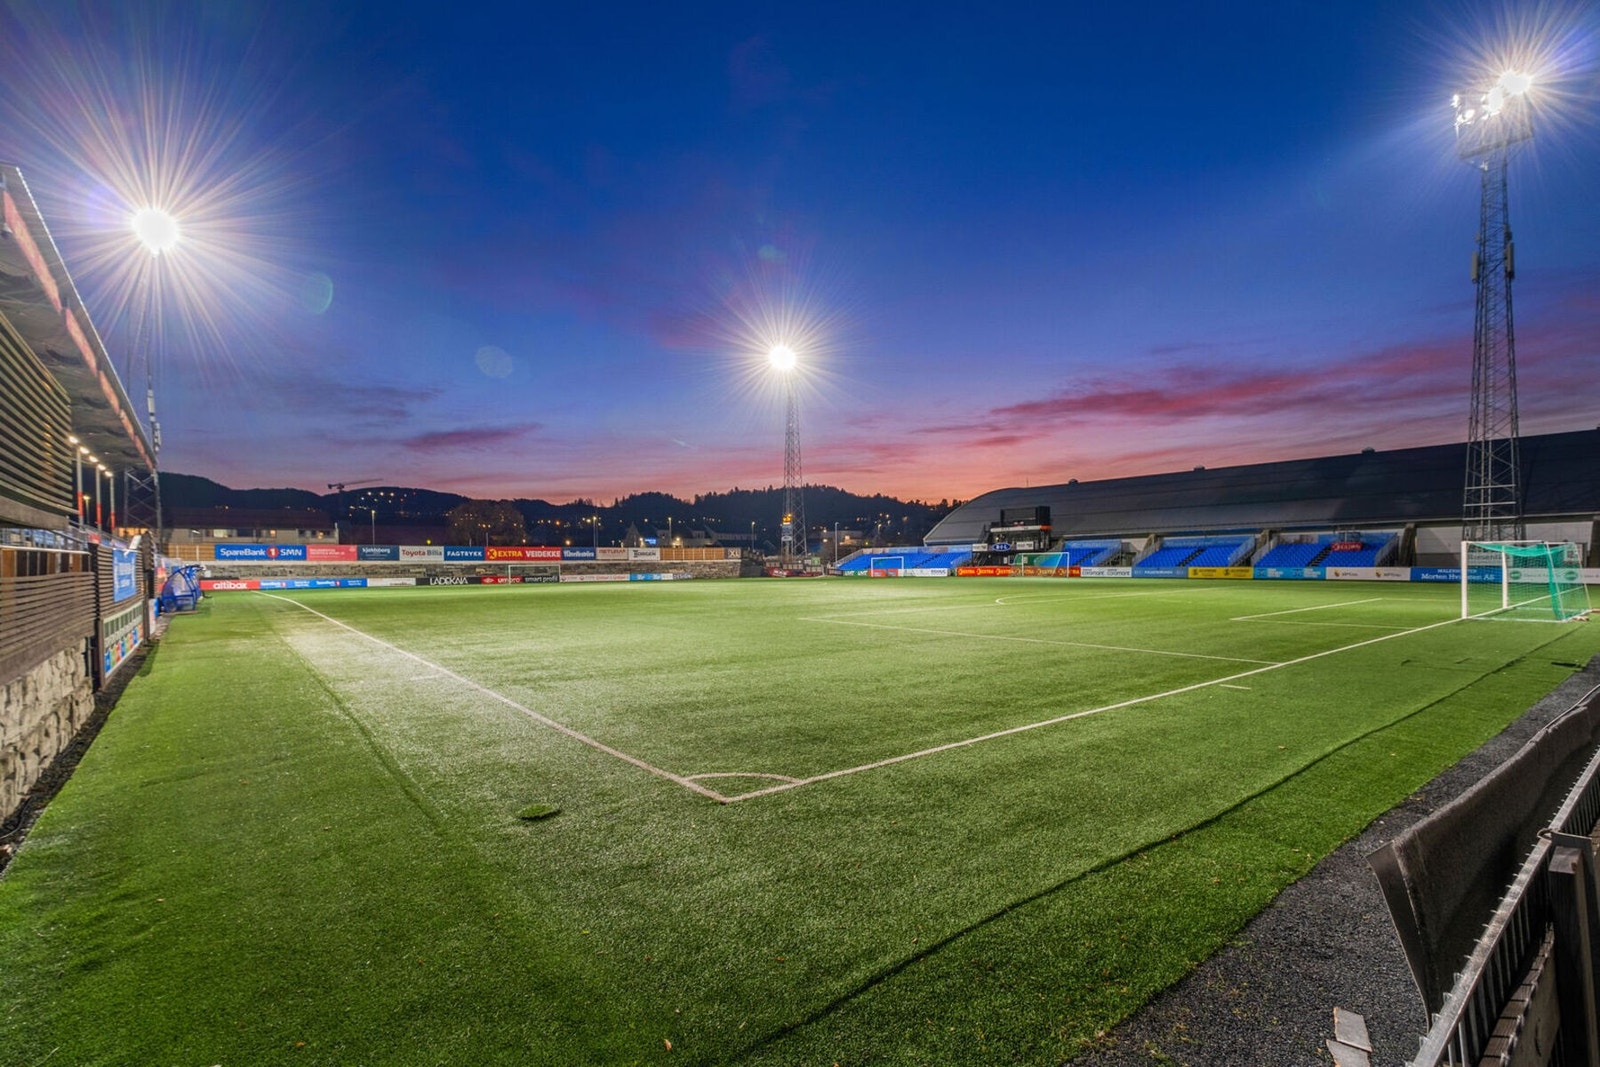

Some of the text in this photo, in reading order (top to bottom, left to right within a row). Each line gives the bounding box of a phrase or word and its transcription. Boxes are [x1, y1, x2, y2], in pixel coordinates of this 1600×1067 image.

[220, 548, 266, 557] SpareBank
[526, 550, 560, 558] VEIDEKKE
[730, 549, 739, 558] XL
[212, 582, 248, 590] altibox
